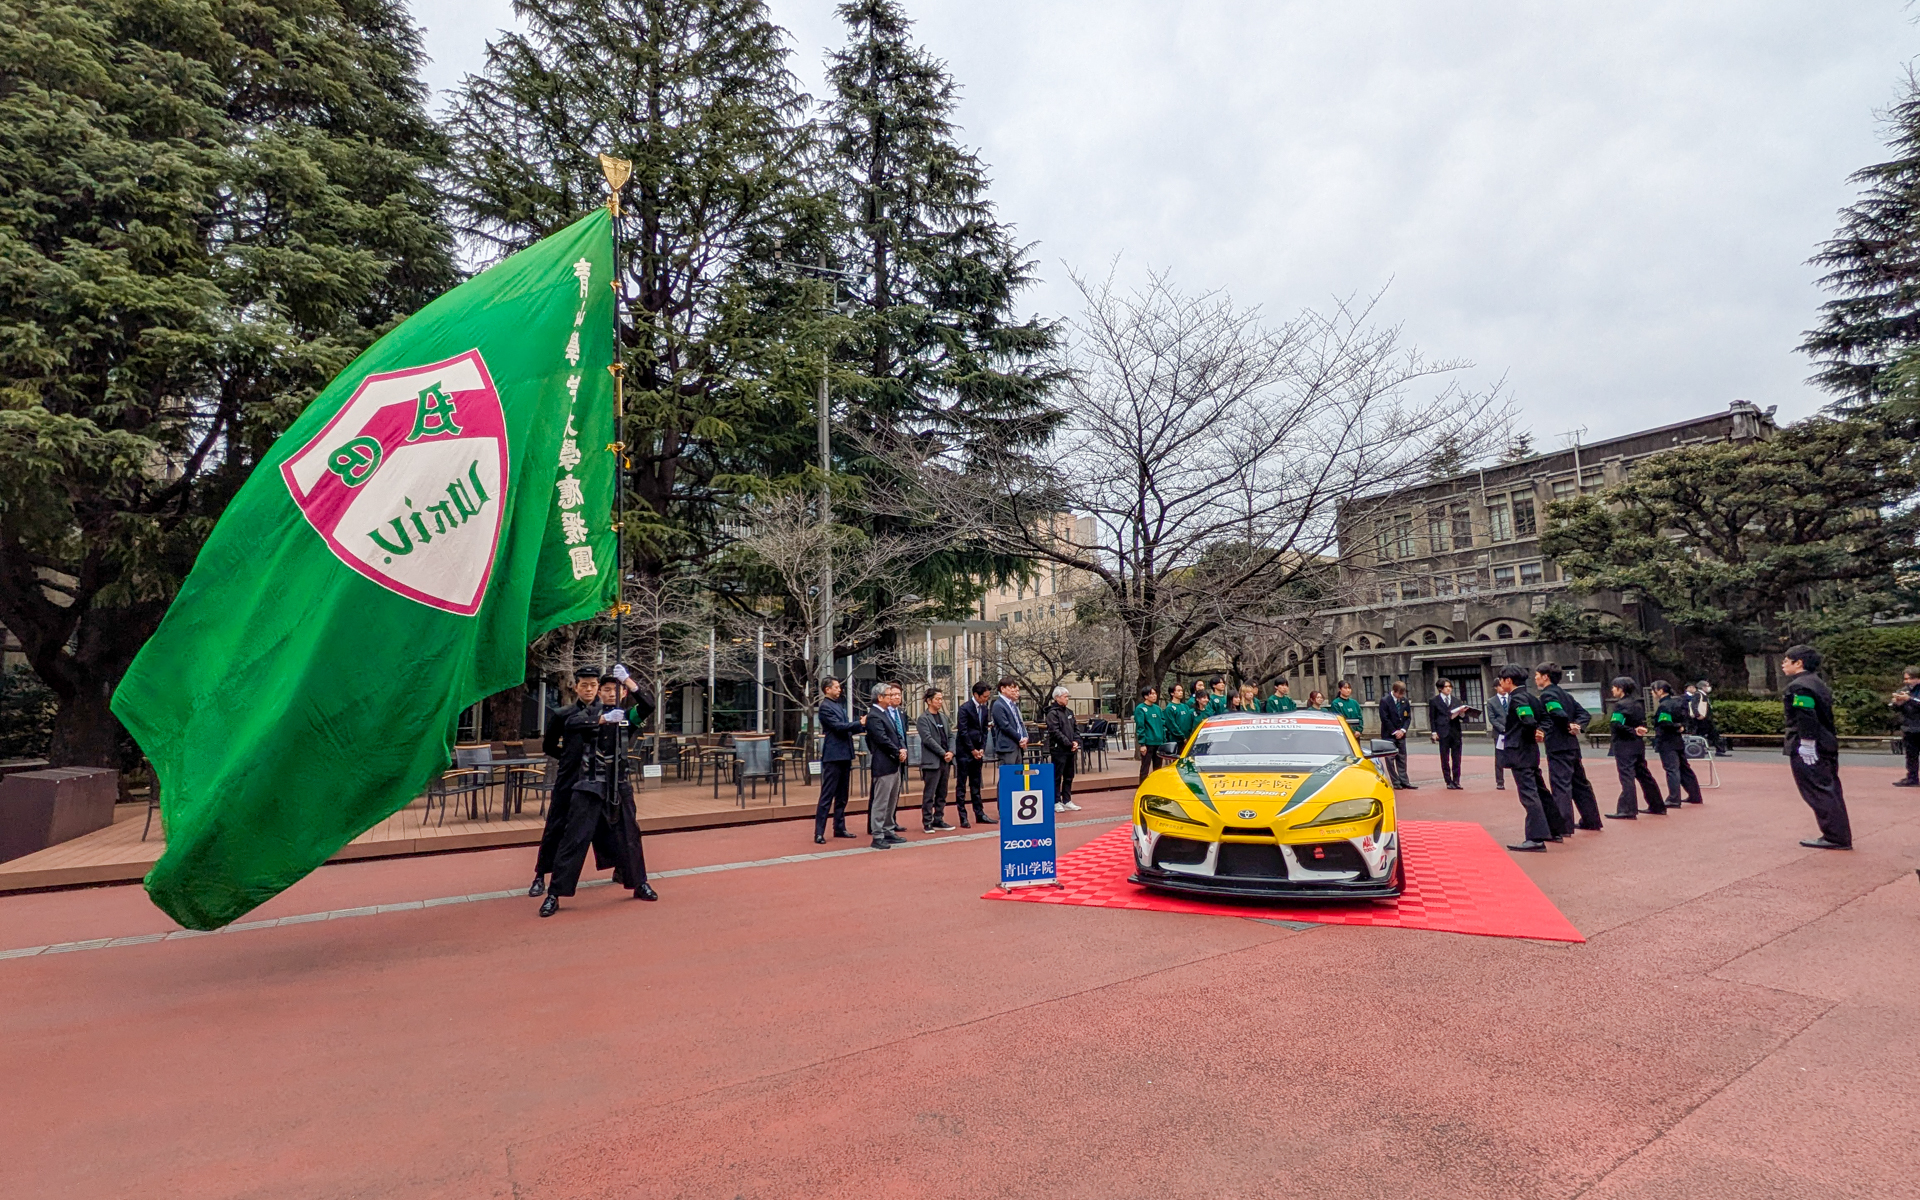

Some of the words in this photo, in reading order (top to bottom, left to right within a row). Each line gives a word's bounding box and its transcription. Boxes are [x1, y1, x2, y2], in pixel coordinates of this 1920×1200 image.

[1212, 779, 1293, 790] 青山学院
[1017, 794, 1038, 820] 8
[1003, 860, 1054, 878] 青山学院
